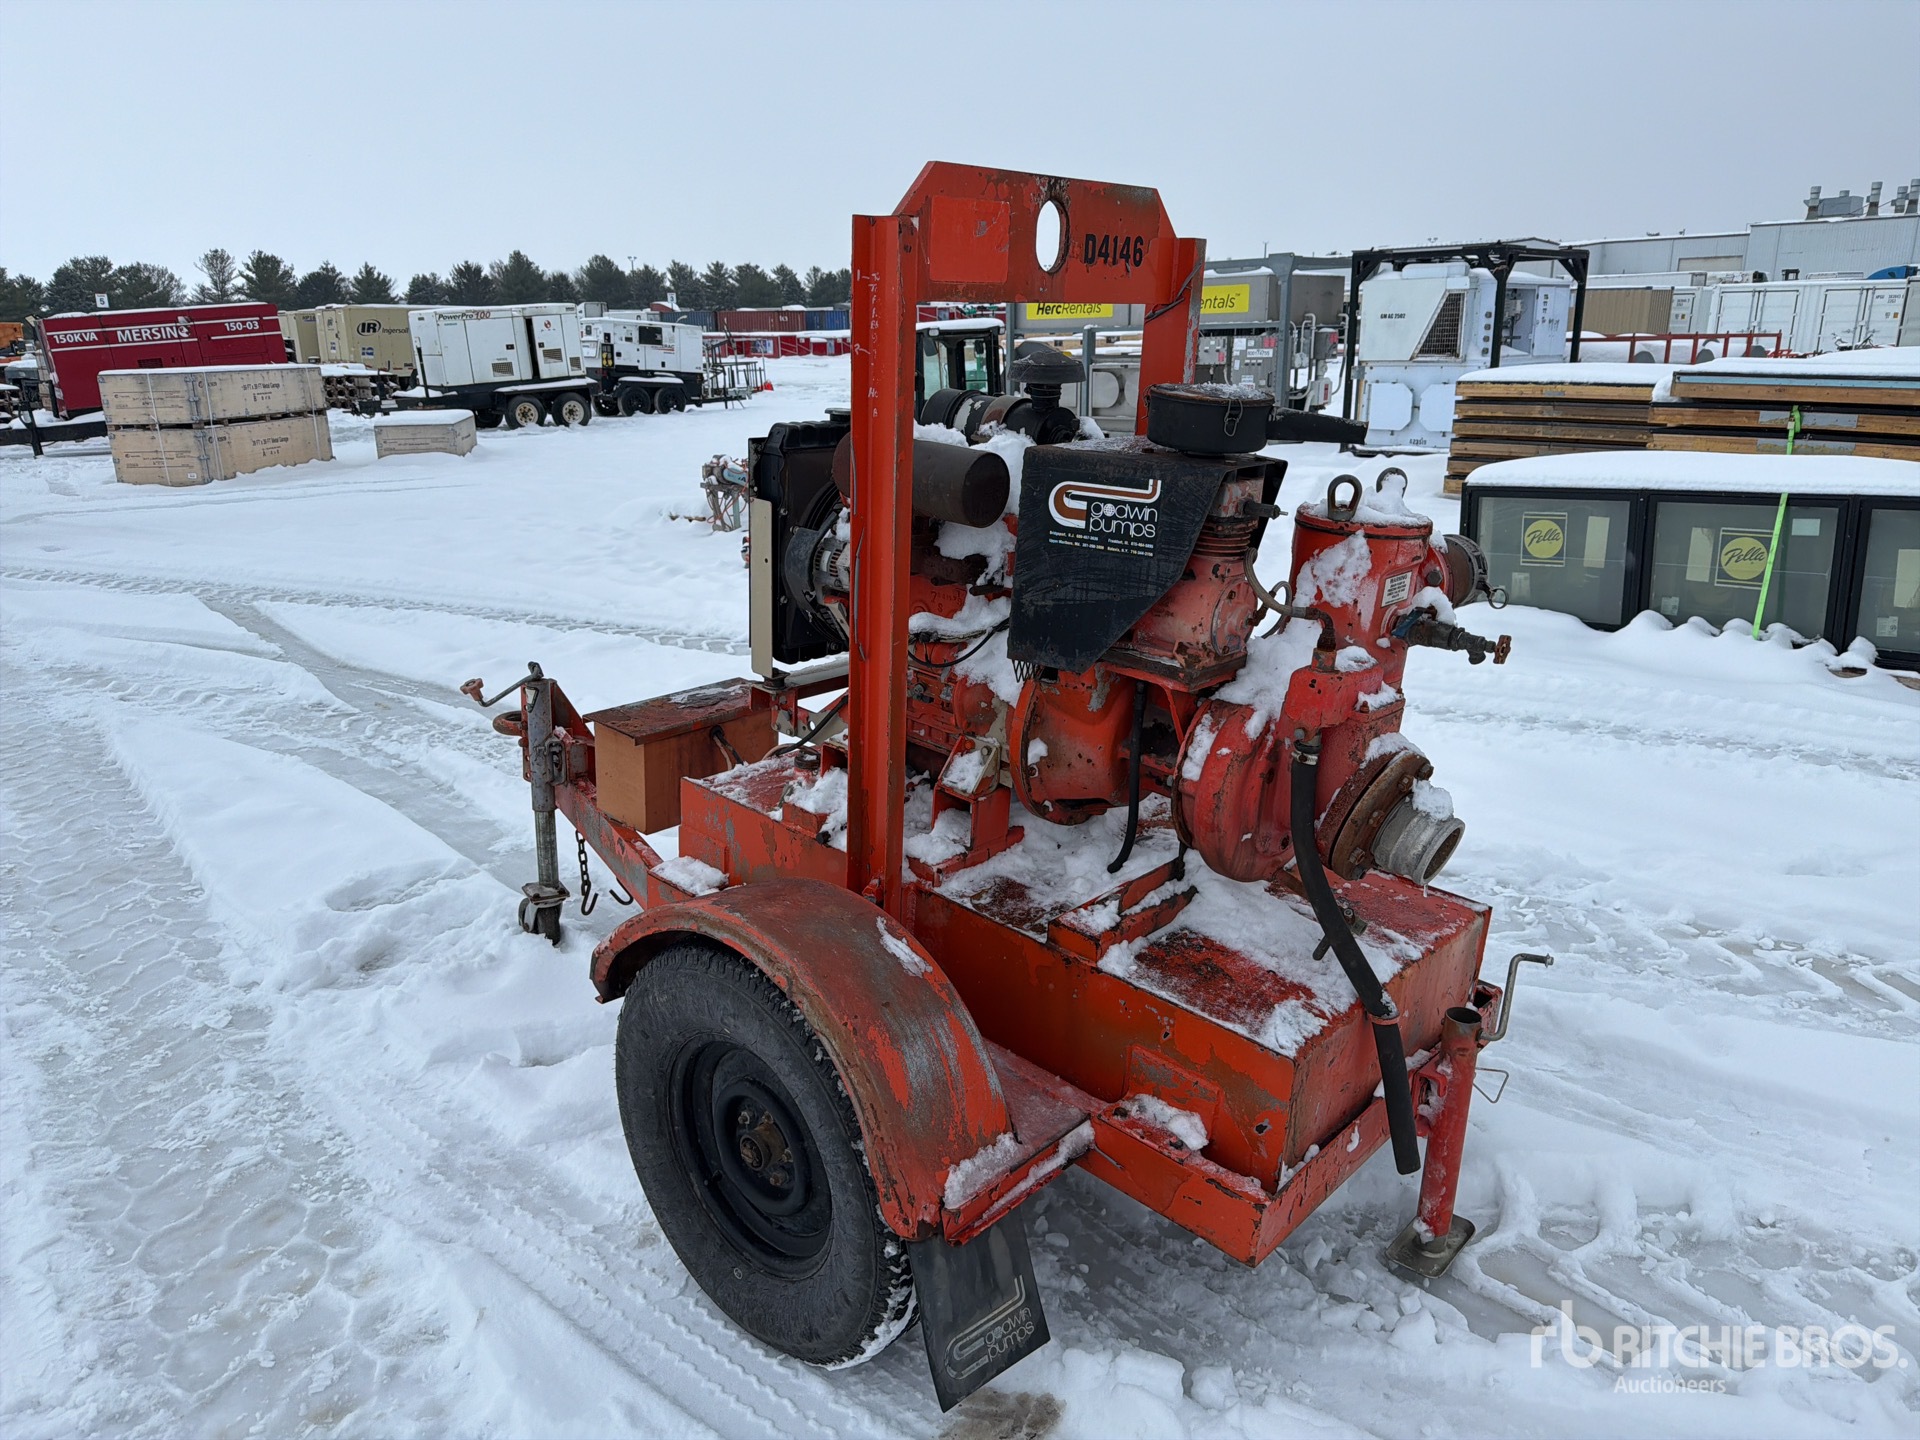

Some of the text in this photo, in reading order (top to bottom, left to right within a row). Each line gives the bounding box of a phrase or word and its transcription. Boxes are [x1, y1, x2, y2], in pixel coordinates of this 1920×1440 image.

[1084, 233, 1144, 267] D4146
[438, 311, 491, 321] PowerPro 100
[1037, 303, 1102, 315] HercRentals
[224, 320, 259, 332] 150-03
[359, 320, 379, 335] IR
[52, 332, 98, 344] 150KVA
[1090, 501, 1158, 522] godwin
[1088, 517, 1156, 538] pumps
[1526, 528, 1561, 548] Pella
[1724, 546, 1766, 566] Pella
[985, 1307, 1032, 1347] godwin
[988, 1321, 1035, 1362] pumps
